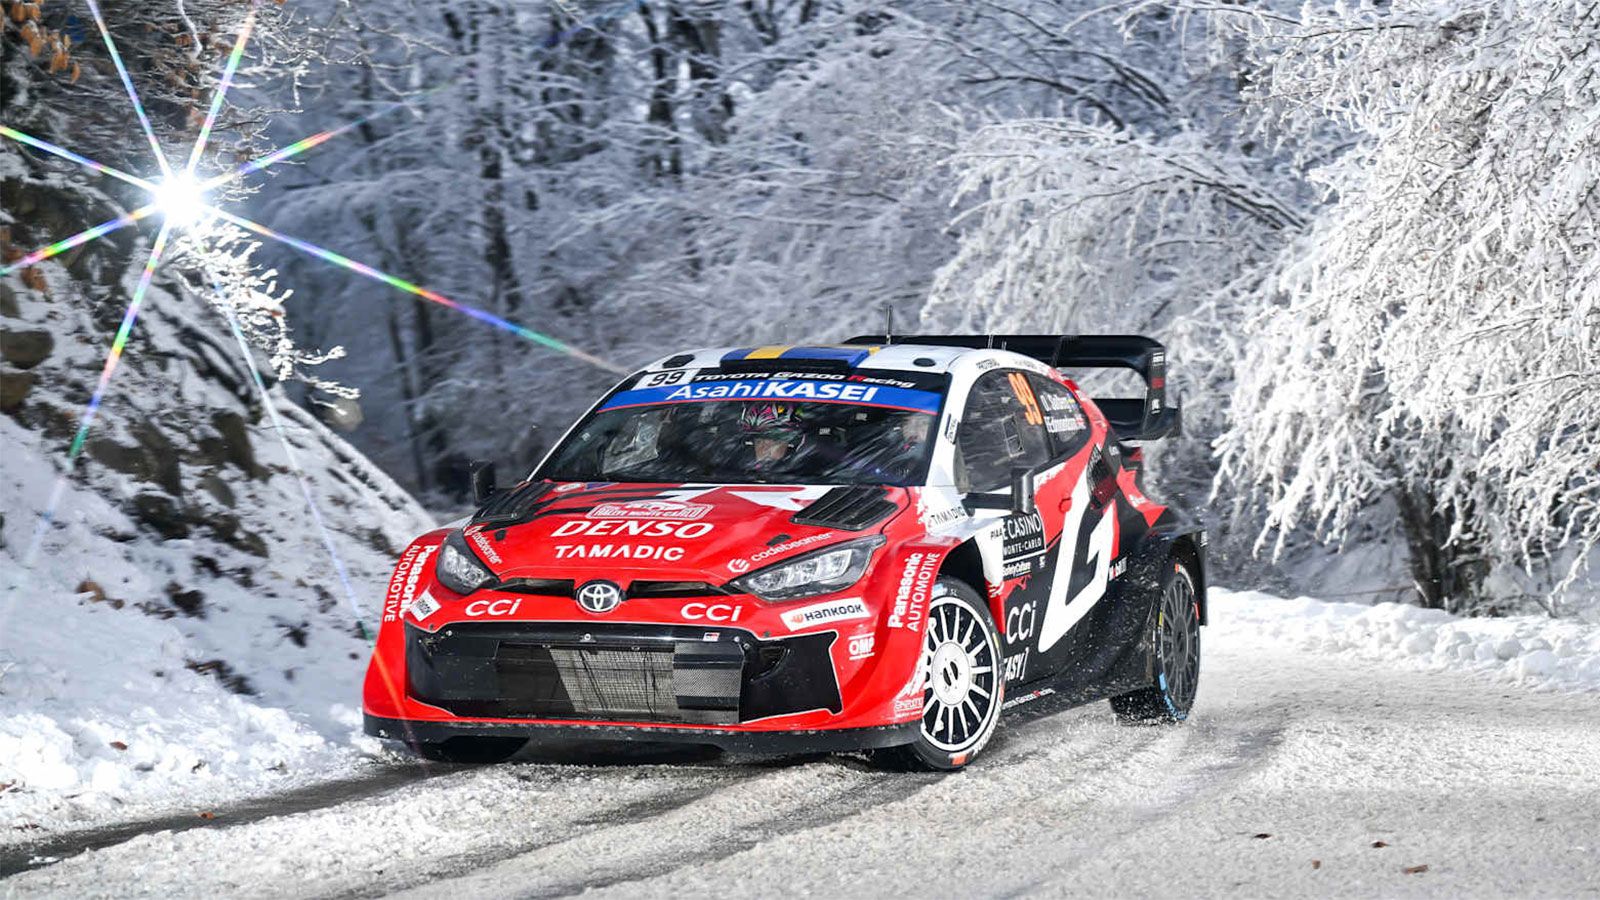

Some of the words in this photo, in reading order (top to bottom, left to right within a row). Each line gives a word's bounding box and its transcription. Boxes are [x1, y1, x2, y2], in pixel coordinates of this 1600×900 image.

[647, 370, 687, 387] 99
[695, 372, 770, 382] TOYOTA
[772, 371, 846, 381] GAZOO
[847, 374, 917, 388] Racing
[1007, 372, 1043, 425] 99
[550, 520, 715, 539] DENSO
[1008, 513, 1042, 540] CASINO
[554, 545, 685, 561] TAMADIC
[751, 532, 833, 562] codebeamer
[384, 545, 421, 622] AUTOMOTIVE
[399, 545, 439, 620] Panasonic
[888, 552, 923, 628] Panasonic
[907, 552, 940, 632] AUTOMOTIVE
[849, 636, 875, 655] OMP
